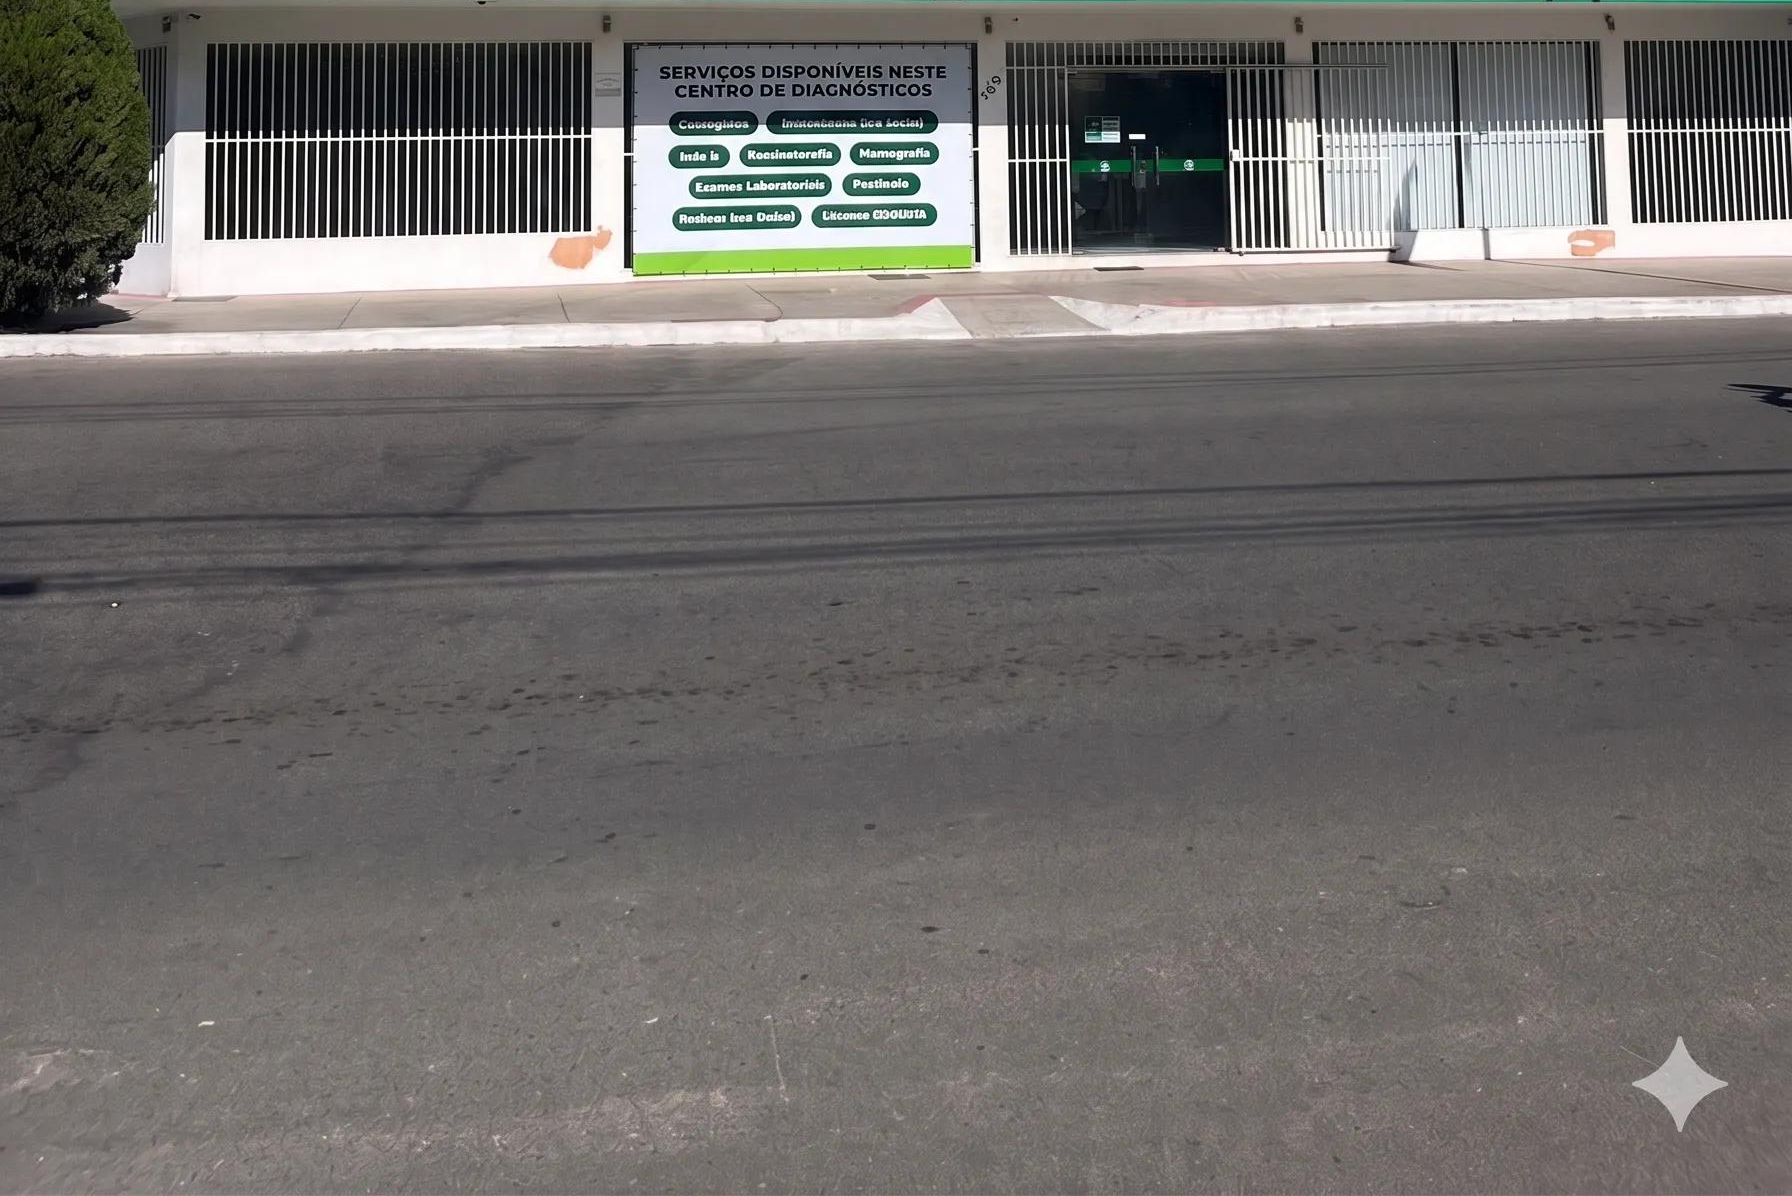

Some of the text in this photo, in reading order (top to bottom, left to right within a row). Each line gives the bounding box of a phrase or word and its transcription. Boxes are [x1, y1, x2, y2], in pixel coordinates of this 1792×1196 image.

[659, 62, 947, 83] SERVIÇOS DISPONÍVEIS NESTE
[674, 80, 932, 98] CENTRO DE DIAGNÓSTICOS
